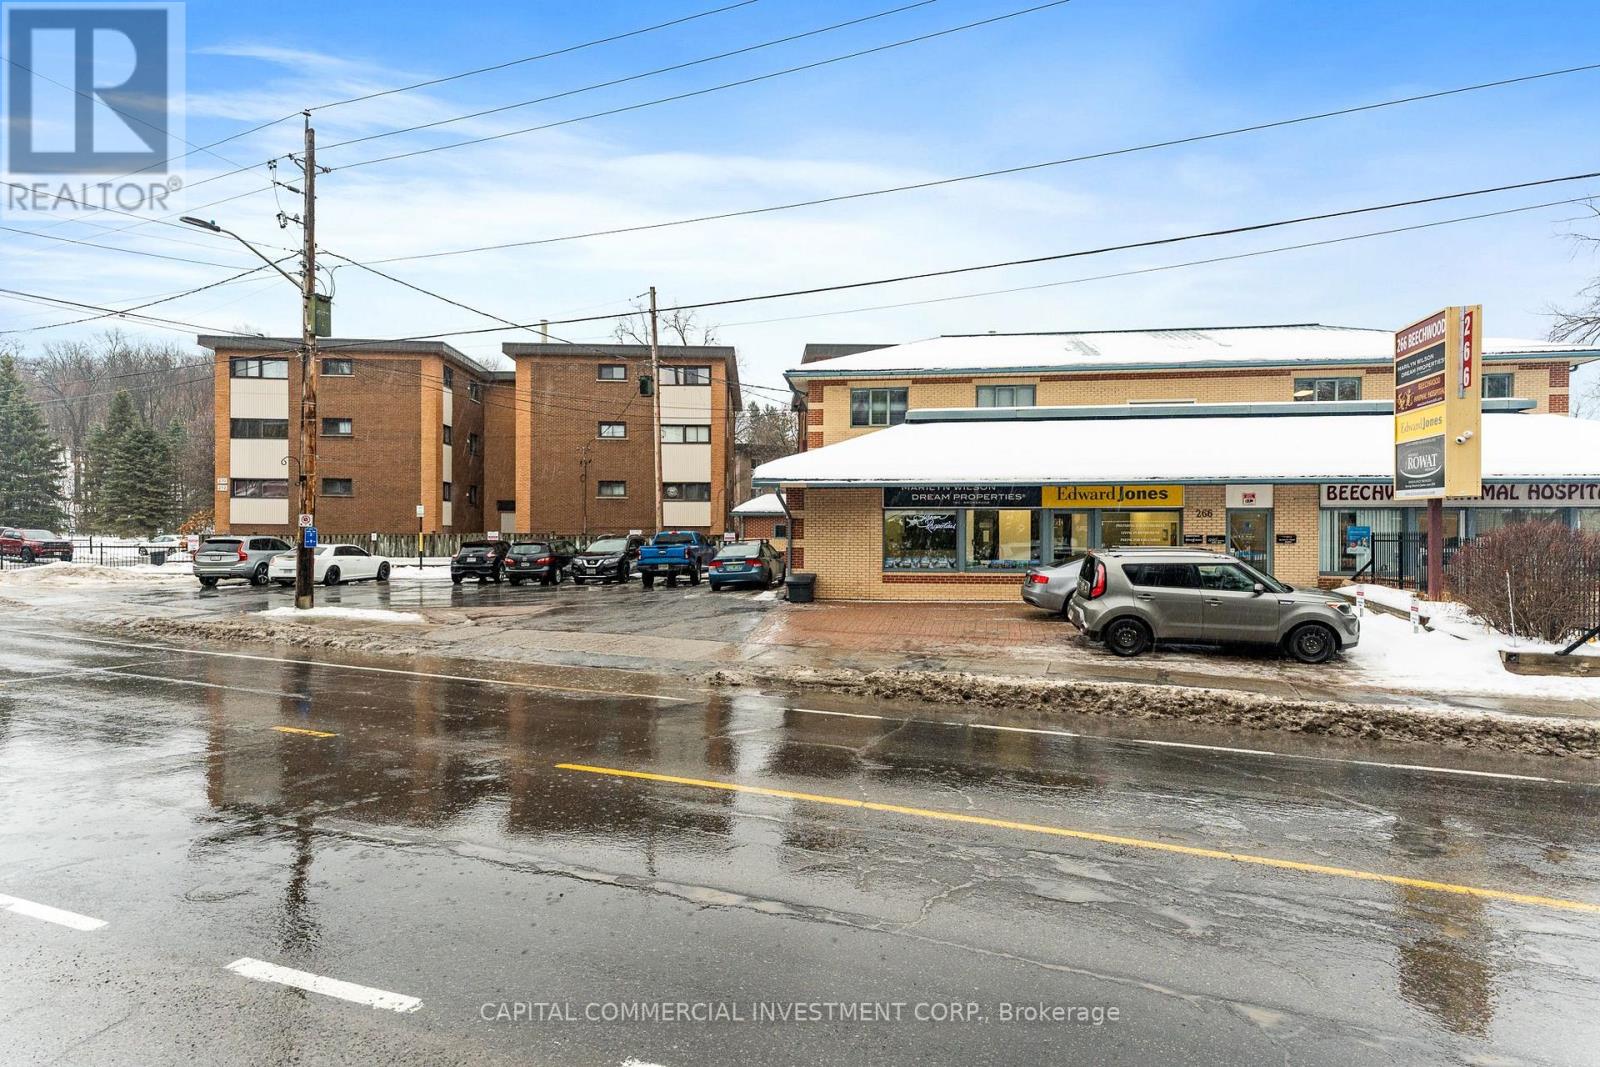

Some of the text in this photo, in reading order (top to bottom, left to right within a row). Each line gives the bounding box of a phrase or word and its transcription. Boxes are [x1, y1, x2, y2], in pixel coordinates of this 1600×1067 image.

[1396, 319, 1445, 353] 266 BEECHWOOD
[1397, 353, 1435, 371] MARILYN WILSON
[1401, 368, 1416, 378] DREAM
[1416, 358, 1445, 373] PROPERTIES
[1407, 453, 1438, 470] ROWAT
[911, 493, 951, 502] DREAM
[1195, 509, 1213, 518] 266
